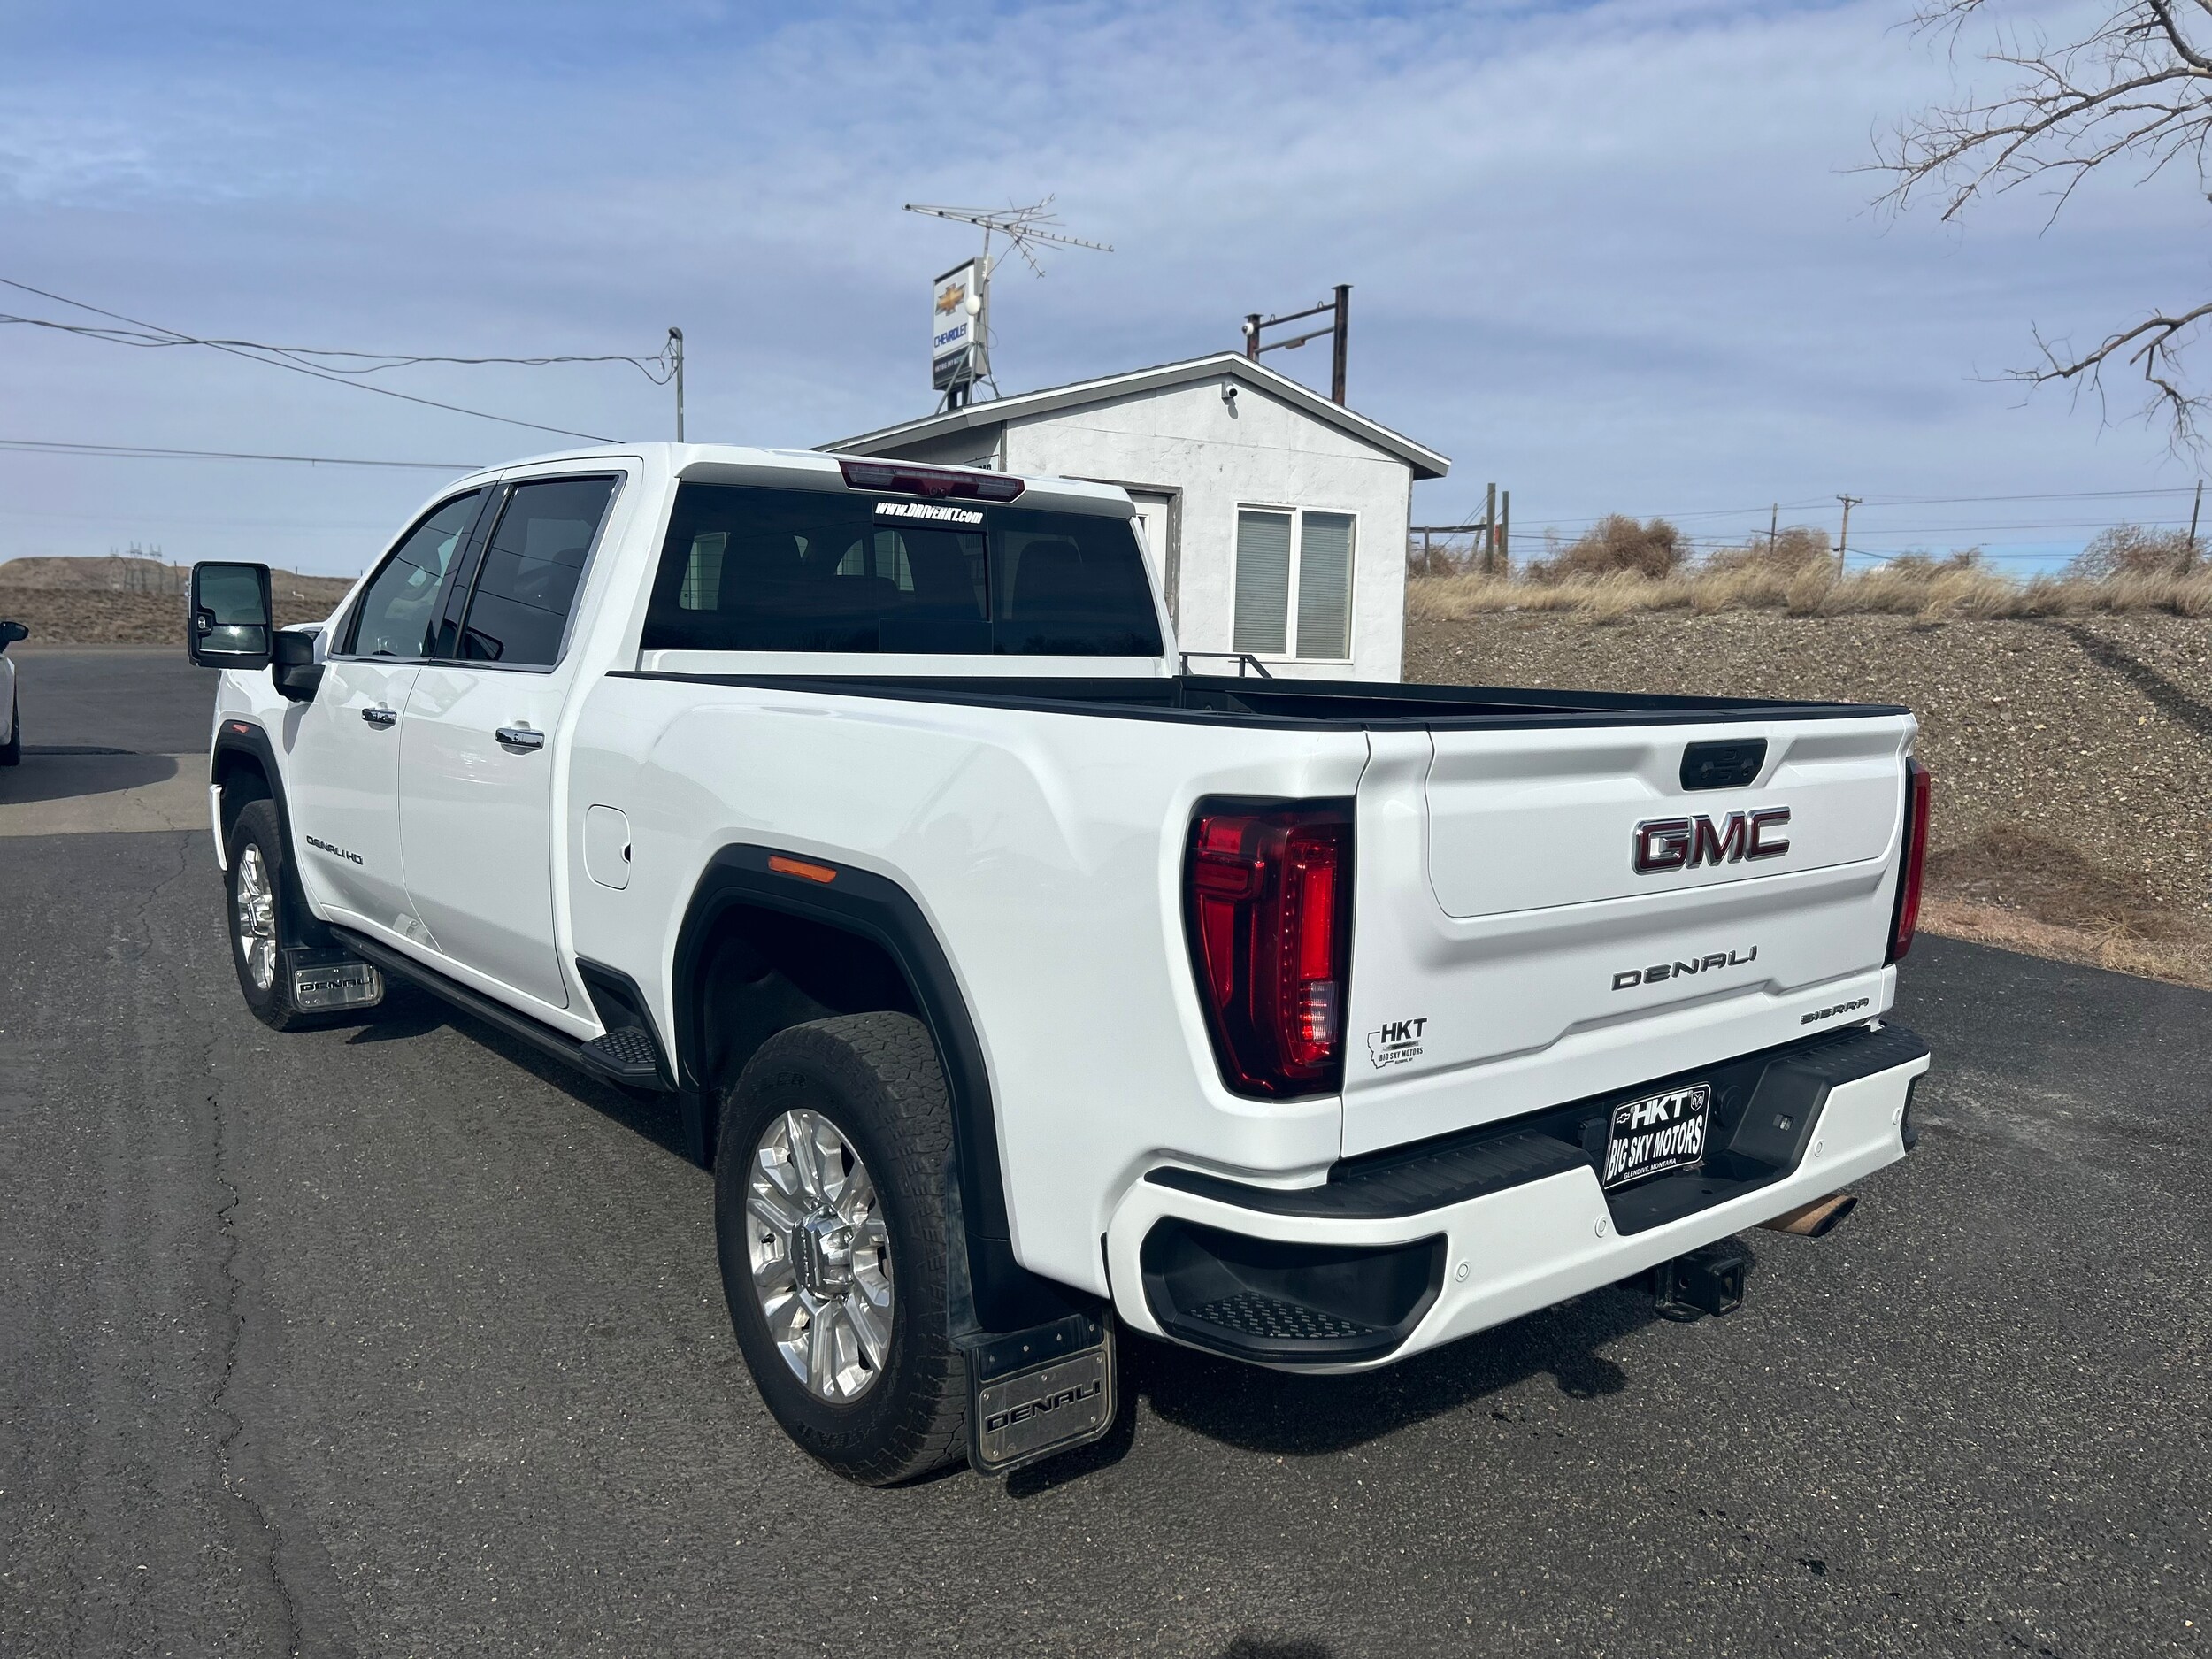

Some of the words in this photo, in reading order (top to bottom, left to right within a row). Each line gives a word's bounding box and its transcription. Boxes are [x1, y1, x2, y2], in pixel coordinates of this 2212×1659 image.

[934, 323, 967, 348] CHEVROLET
[874, 502, 984, 524] www.DRIVEHKT.com
[305, 835, 345, 858] DENALI
[346, 850, 364, 865] HD
[1631, 806, 1791, 876] GMC
[1611, 945, 1757, 991] DENALI
[298, 977, 375, 994] DENALI
[1800, 997, 1870, 1025] SIERRA
[1380, 1018, 1428, 1043] HKT
[1379, 1053, 1389, 1062] BIG
[1390, 1051, 1401, 1060] SKY
[1402, 1047, 1424, 1058] MOTORS
[1631, 1091, 1688, 1130] HKT
[1606, 1138, 1629, 1181] BIG
[1628, 1133, 1654, 1168] SKY
[1653, 1114, 1703, 1158] MOTORS
[1624, 1165, 1650, 1179] GLENDIVE,
[1650, 1157, 1677, 1171] MONTANA
[985, 1378, 1102, 1434] DENALI
